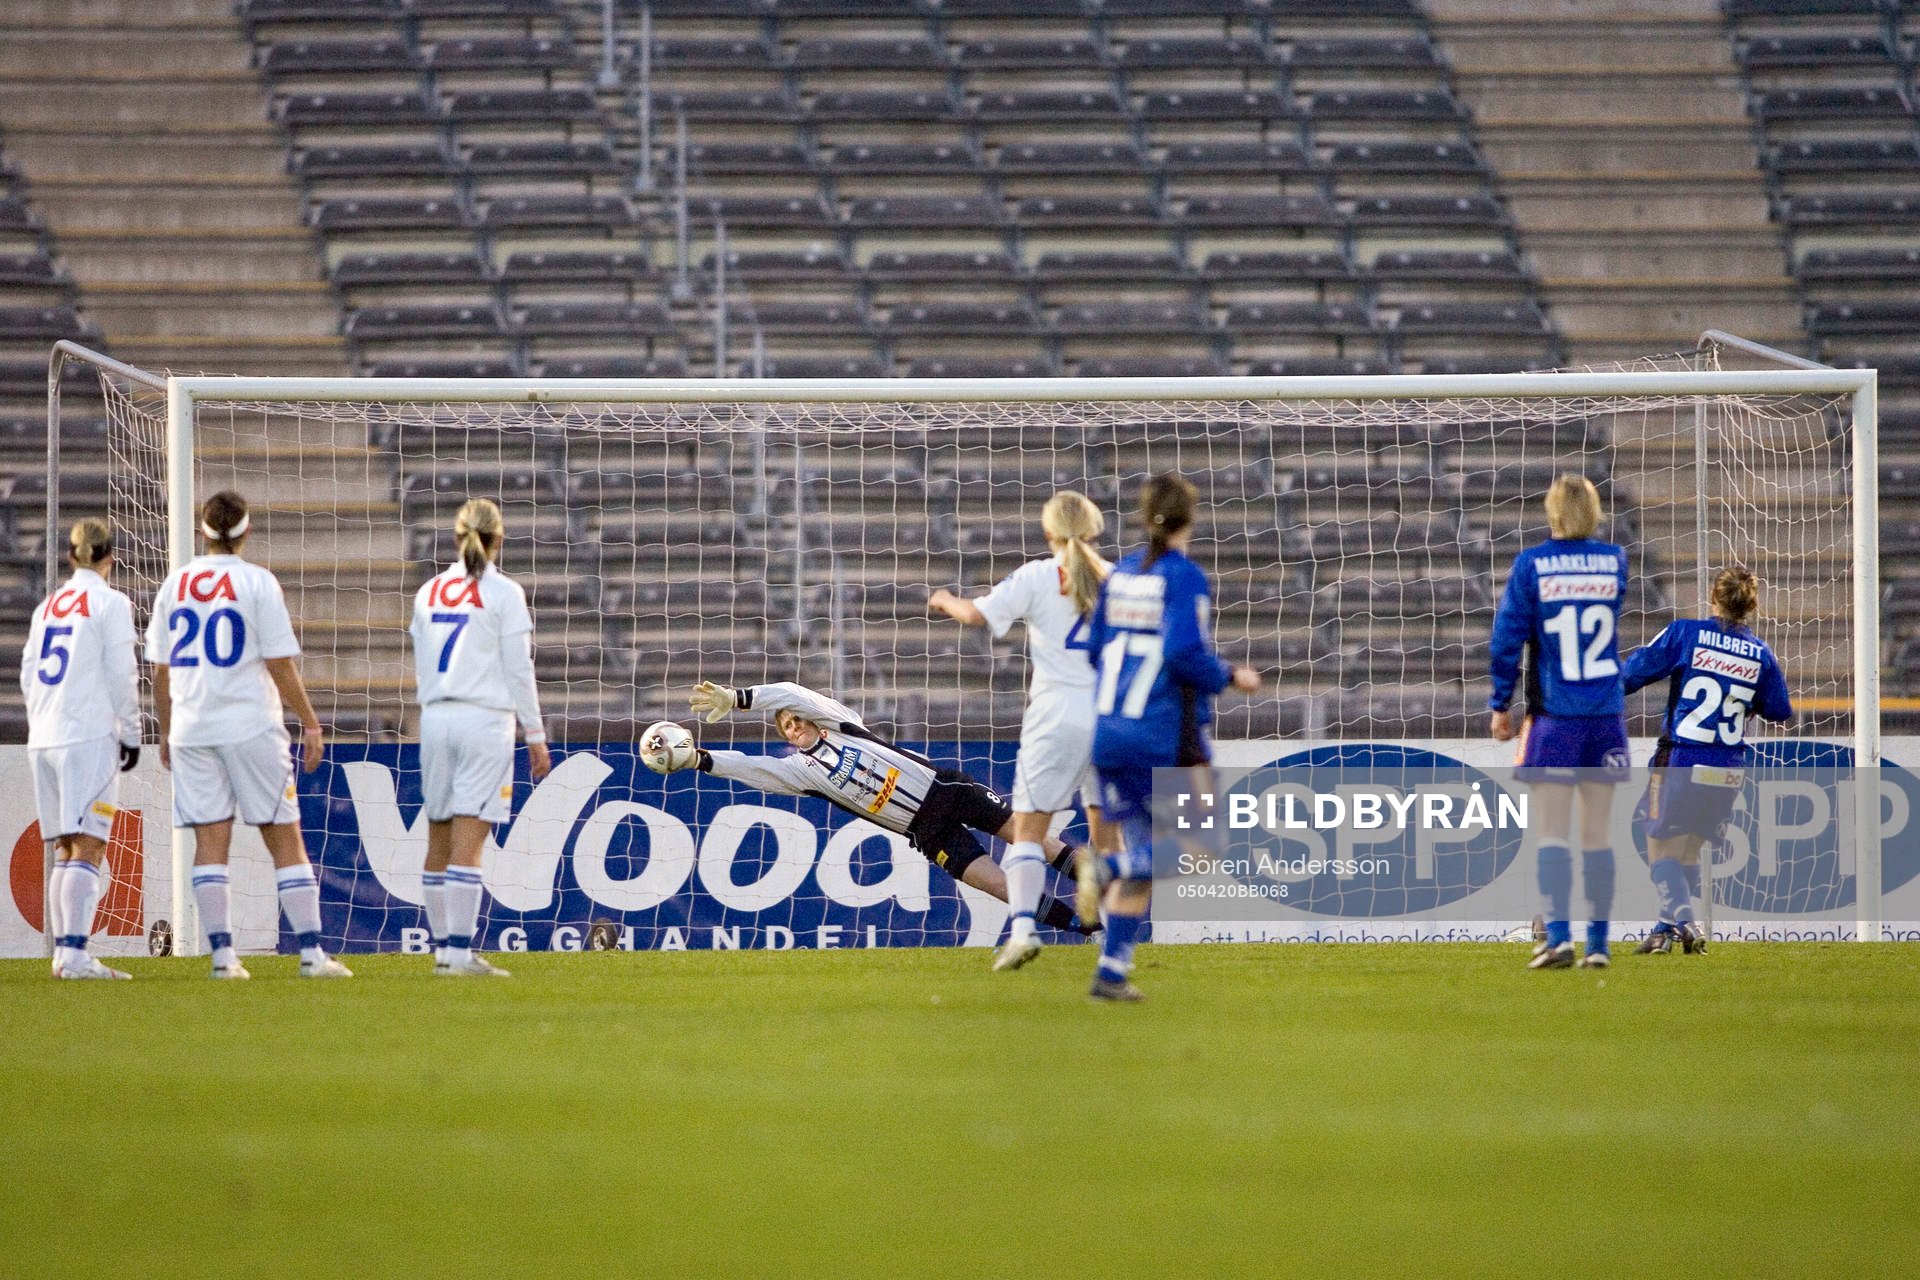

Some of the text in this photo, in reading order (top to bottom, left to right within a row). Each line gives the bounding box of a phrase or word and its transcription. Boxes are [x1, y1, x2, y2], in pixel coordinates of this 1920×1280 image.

[43, 590, 91, 620] ICA
[178, 570, 238, 603] ICA
[428, 577, 484, 609] ICA
[38, 626, 73, 685] 5
[169, 608, 246, 668] 20
[431, 613, 469, 672] 7
[1543, 603, 1619, 681] 12
[1698, 629, 1764, 659] MILBRETT
[1096, 631, 1165, 720] 17
[1676, 675, 1756, 746] 25
[873, 775, 896, 809] DHL
